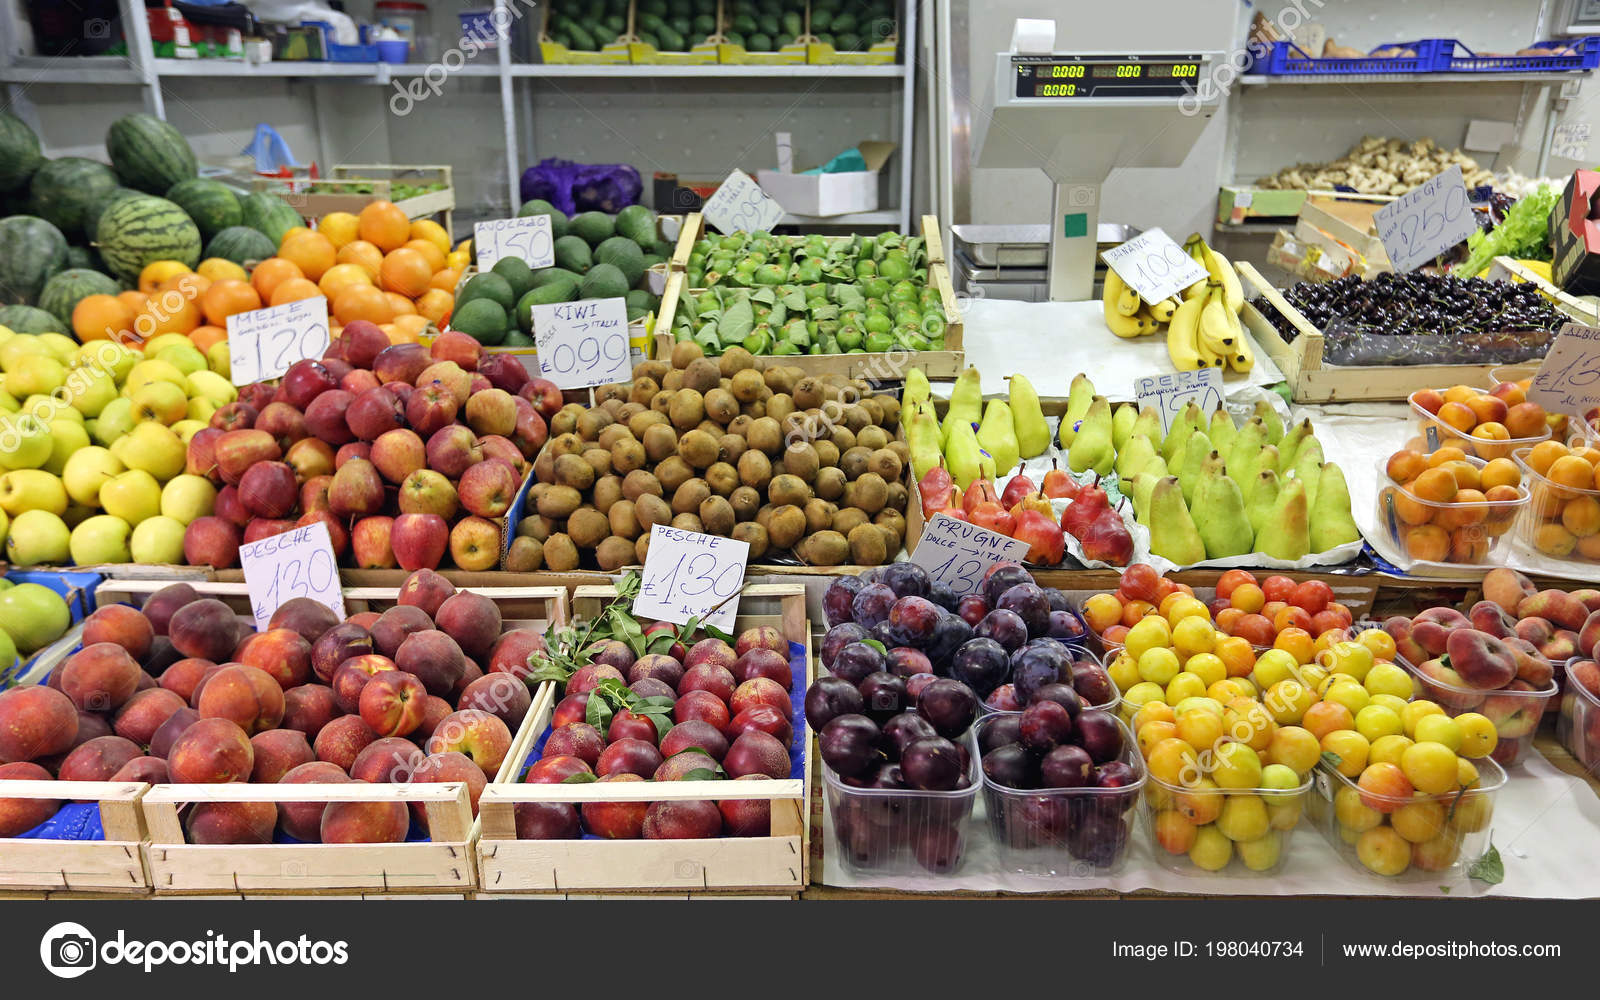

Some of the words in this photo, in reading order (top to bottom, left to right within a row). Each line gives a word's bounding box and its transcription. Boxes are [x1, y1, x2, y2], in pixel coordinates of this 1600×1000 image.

[1052, 65, 1085, 78] 0.000
[1116, 65, 1141, 78] 0.00
[1172, 64, 1197, 77] 0.00
[1043, 84, 1076, 96] 0.000
[477, 216, 546, 232] AVOCADO
[554, 303, 598, 321] KIWI
[591, 319, 619, 329] ITALIA
[1140, 367, 1211, 392] PERE
[242, 525, 316, 561] PESCHE
[658, 526, 722, 549] PESCHE
[925, 532, 957, 549] DOLCE
[937, 518, 1016, 552] PRUGNE
